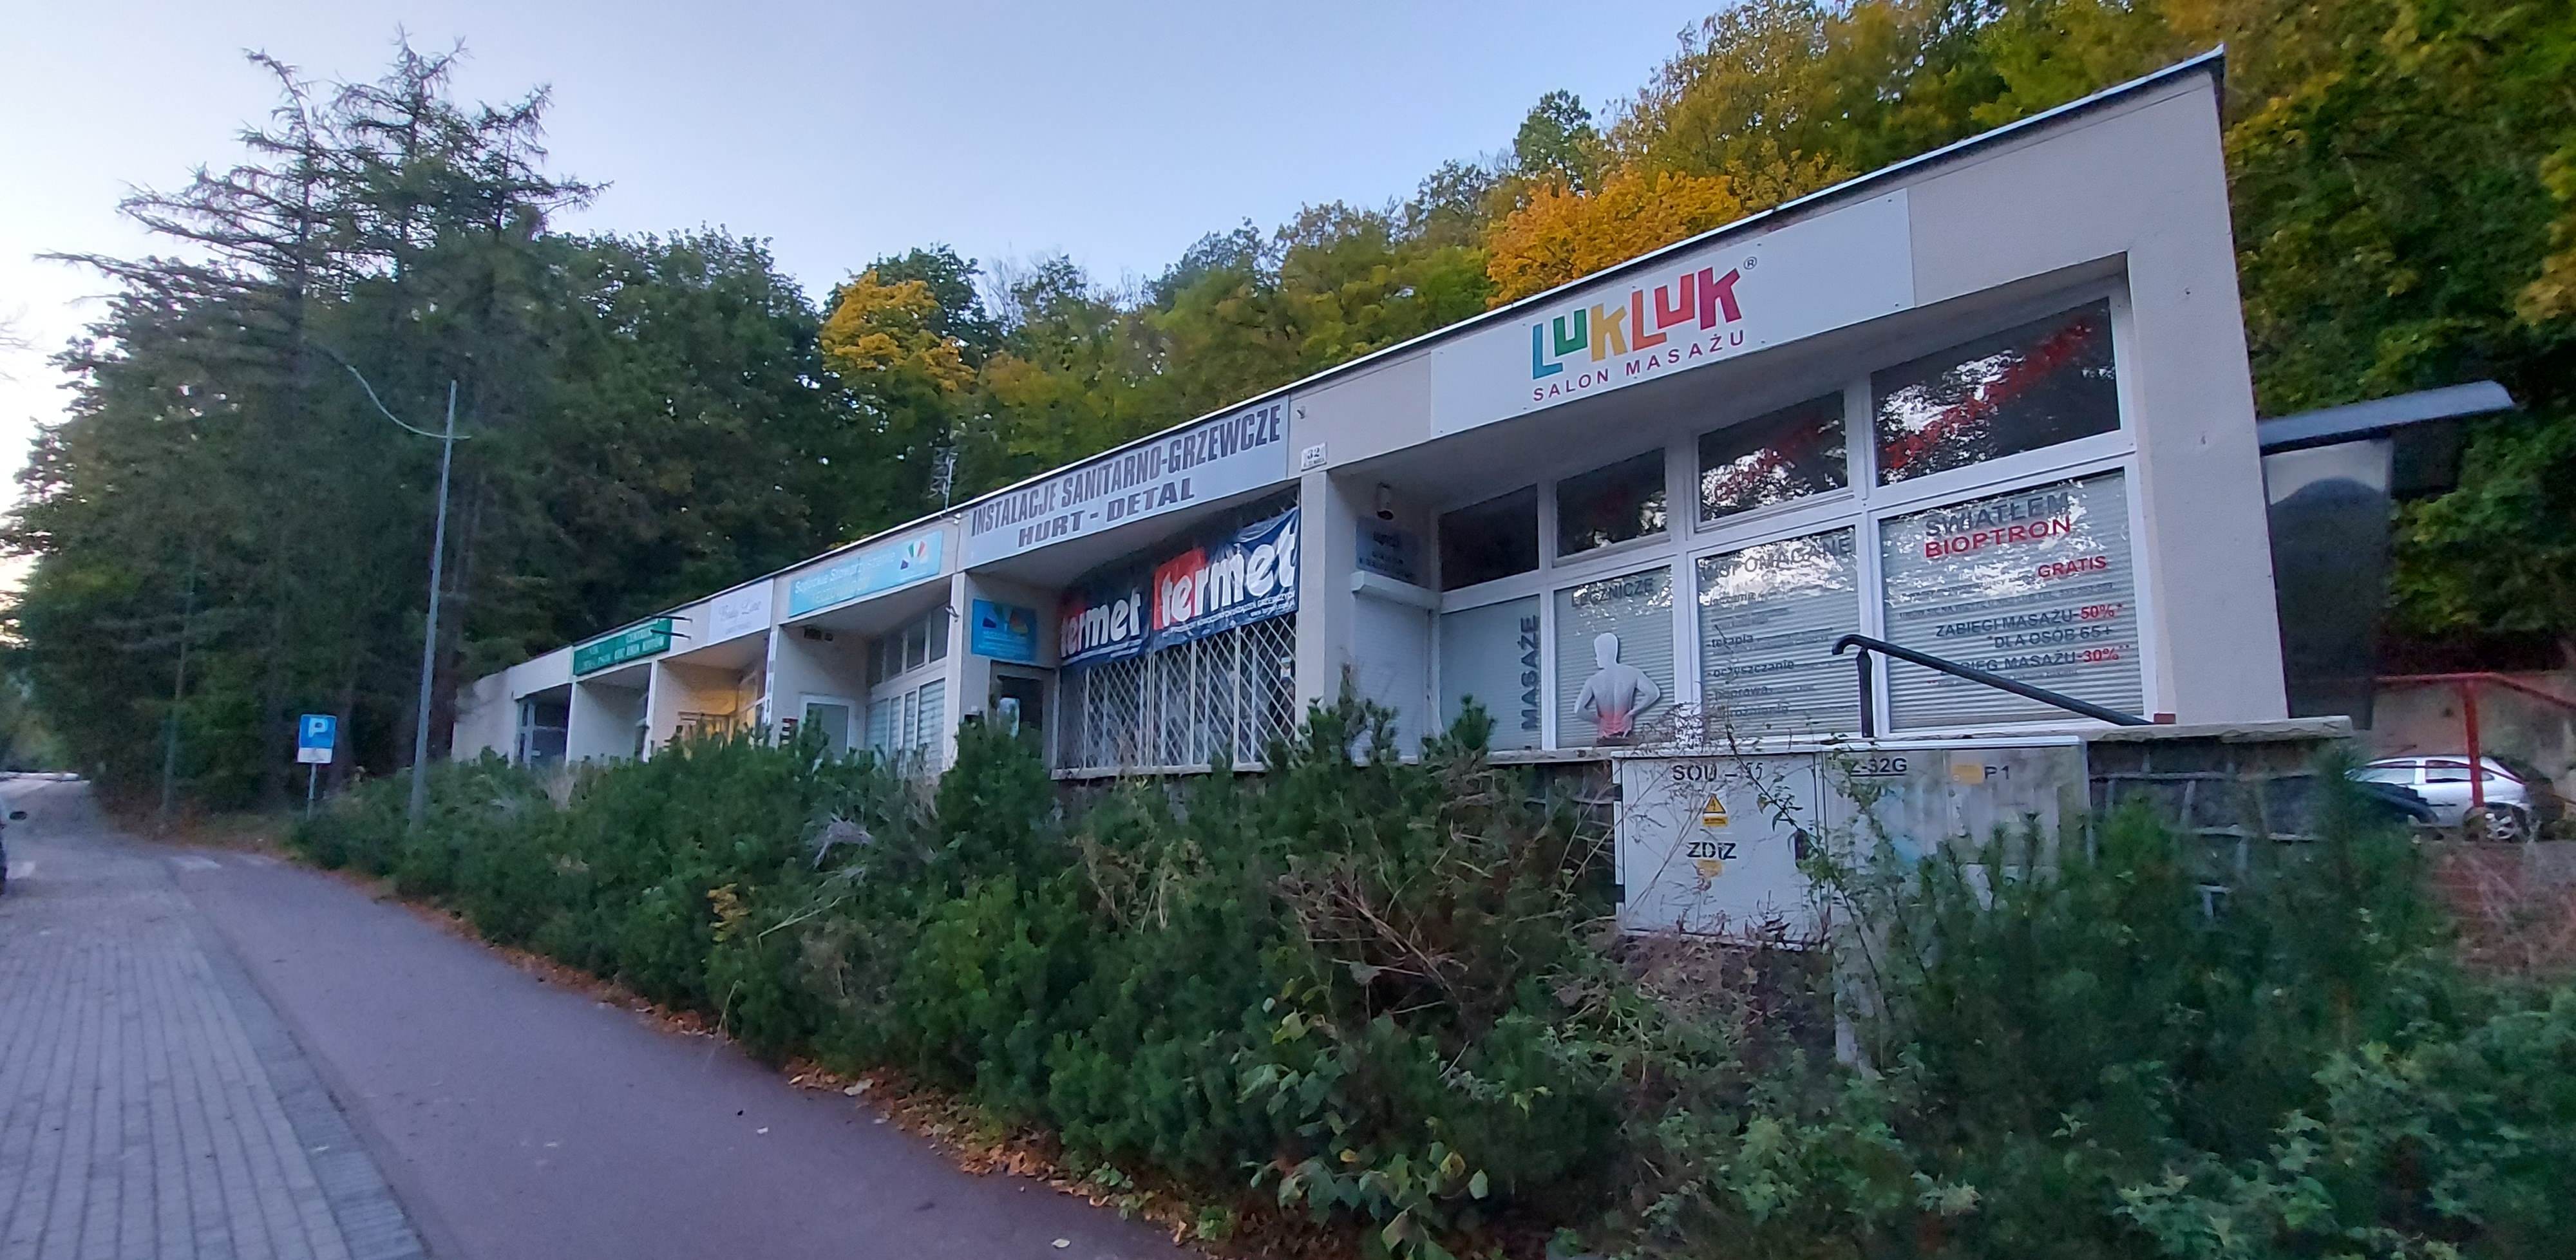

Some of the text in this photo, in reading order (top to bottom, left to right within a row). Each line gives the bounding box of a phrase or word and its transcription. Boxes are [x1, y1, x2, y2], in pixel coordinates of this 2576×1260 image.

[1533, 329, 1745, 402] SALON MASAŻU
[971, 404, 1280, 537] INSTALACJE SANITARNO-GRZEWCZE
[1307, 447, 1320, 460] 32
[1018, 510, 1085, 548] HURT
[1106, 477, 1194, 522] DETAL
[1926, 516, 2070, 558] BIOPTRON
[1161, 520, 1295, 626] termet
[2038, 556, 2107, 578] GRATIS
[1061, 587, 1141, 658] termet
[1936, 619, 1997, 637] ZABIEGI
[1517, 615, 1539, 729] MASAŻE
[308, 717, 328, 737] P
[1672, 764, 1718, 782] SOU
